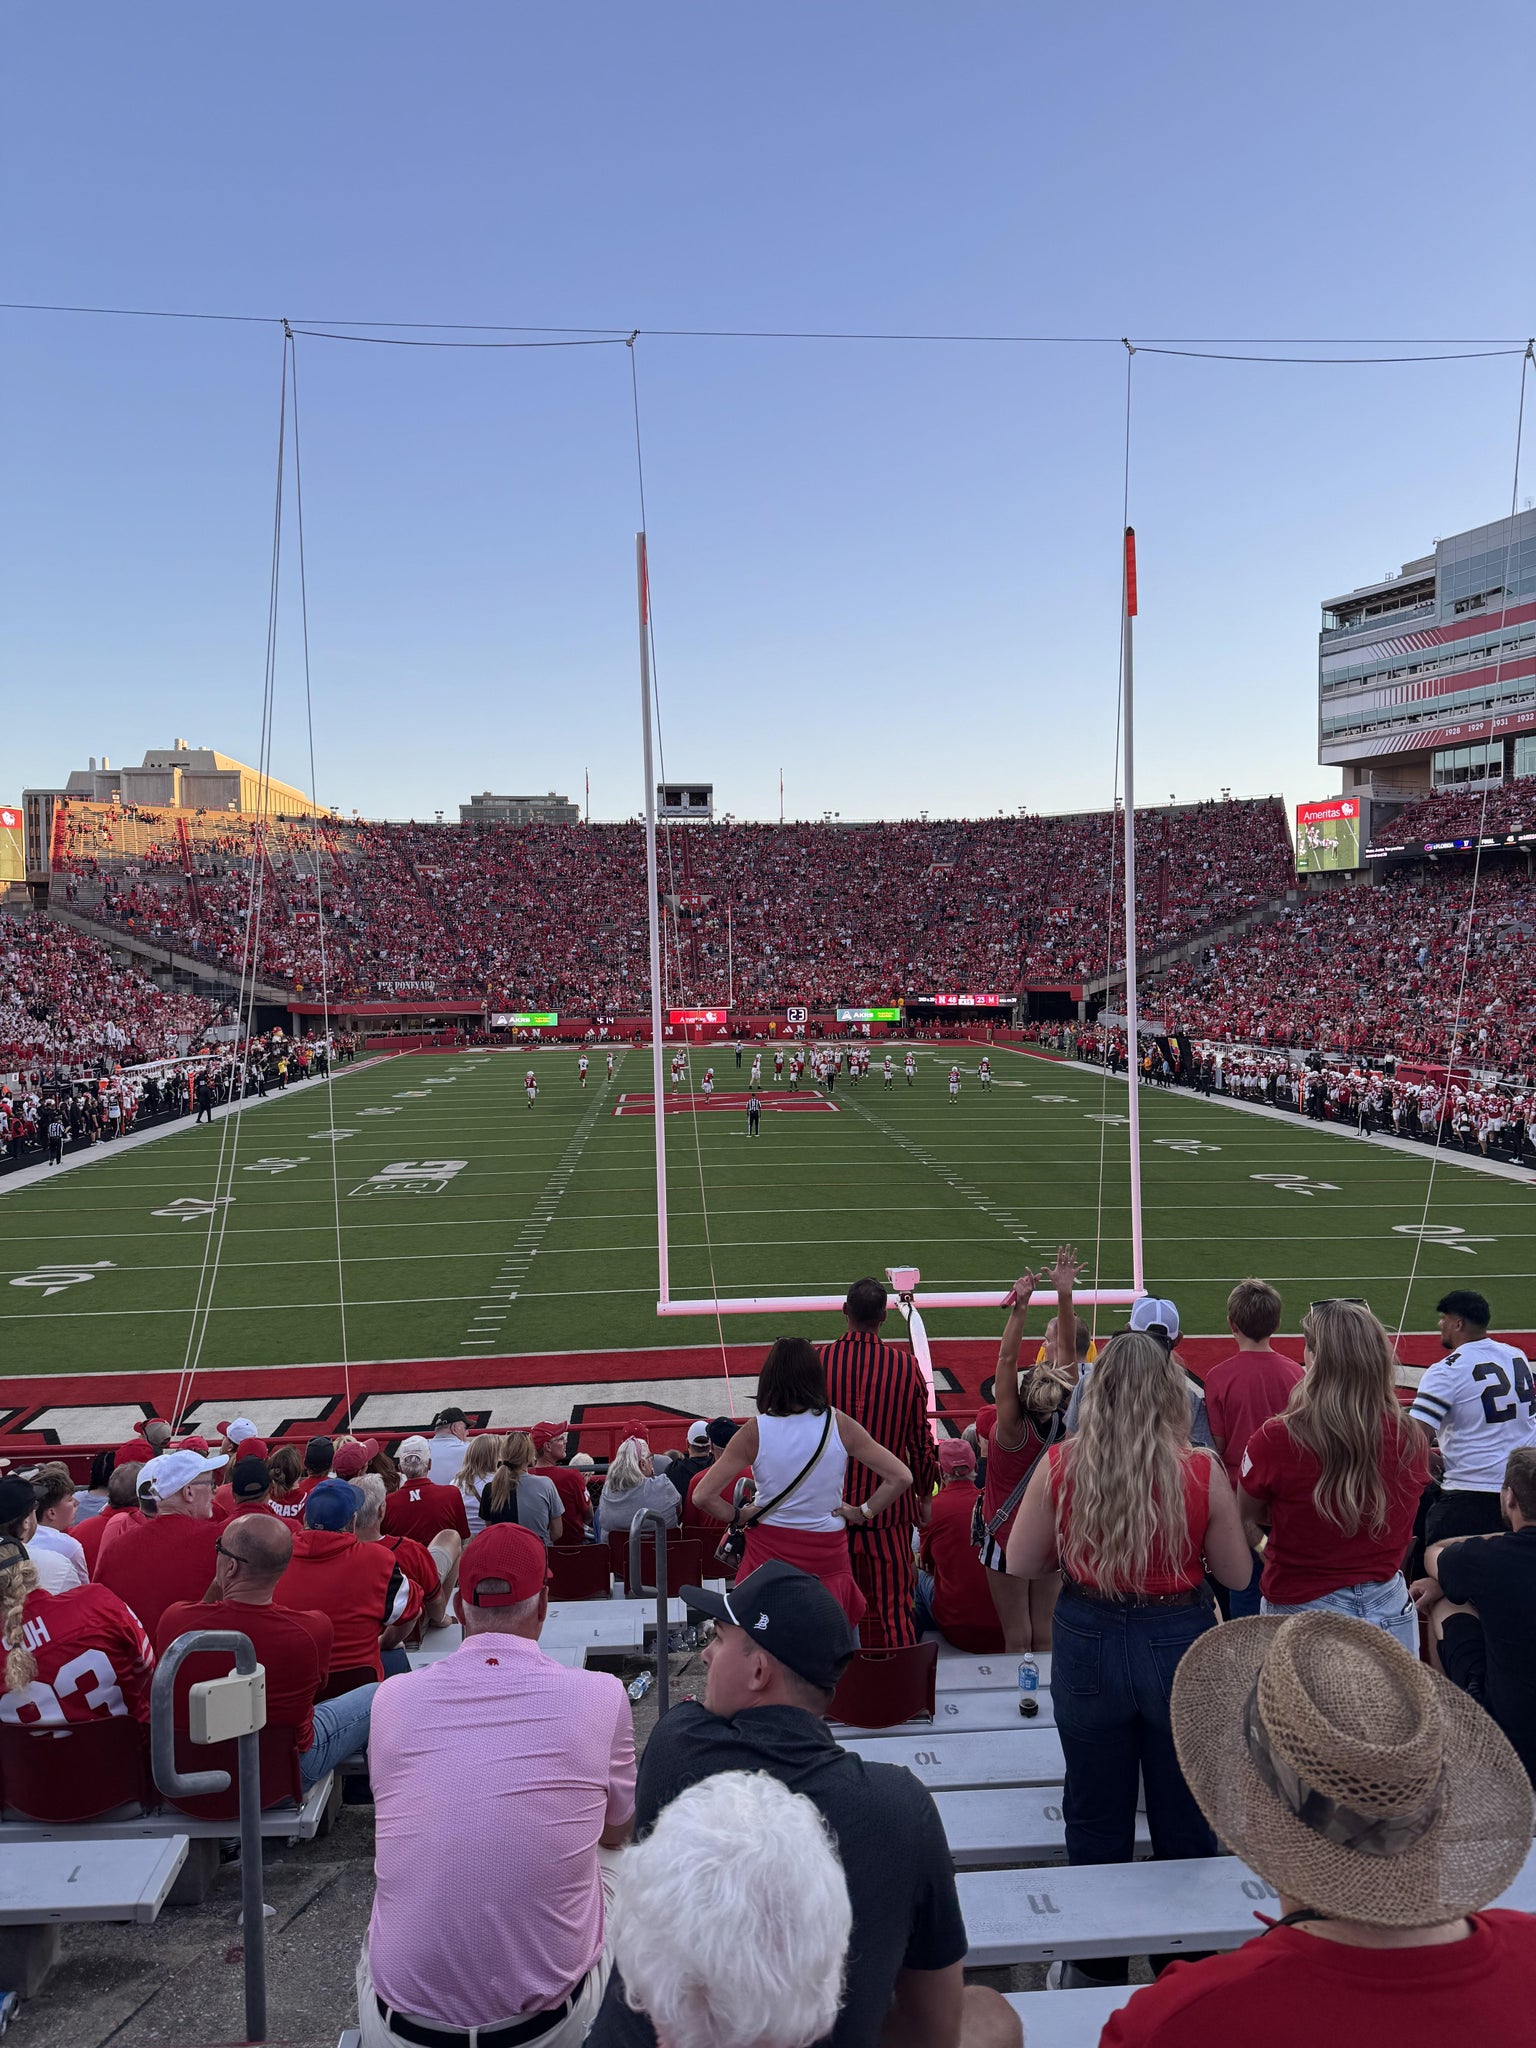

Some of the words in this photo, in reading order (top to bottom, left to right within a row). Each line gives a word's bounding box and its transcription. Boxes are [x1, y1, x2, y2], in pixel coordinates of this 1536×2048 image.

[1445, 727, 1461, 736] 1928
[1468, 722, 1484, 732] 1929
[1493, 718, 1508, 728] 1931
[1517, 713, 1535, 723] 1932
[1304, 809, 1341, 820] Ameritas
[790, 1009, 805, 1022] 23
[1152, 1138, 1222, 1152] 30
[242, 1156, 311, 1172] 30
[1249, 1173, 1343, 1191] 20
[150, 1196, 237, 1217] 20
[1391, 1223, 1498, 1245] 10
[8, 1260, 118, 1289] 10
[1471, 1356, 1536, 1424] 24
[409, 1489, 421, 1502] N
[978, 1665, 993, 1675] 8
